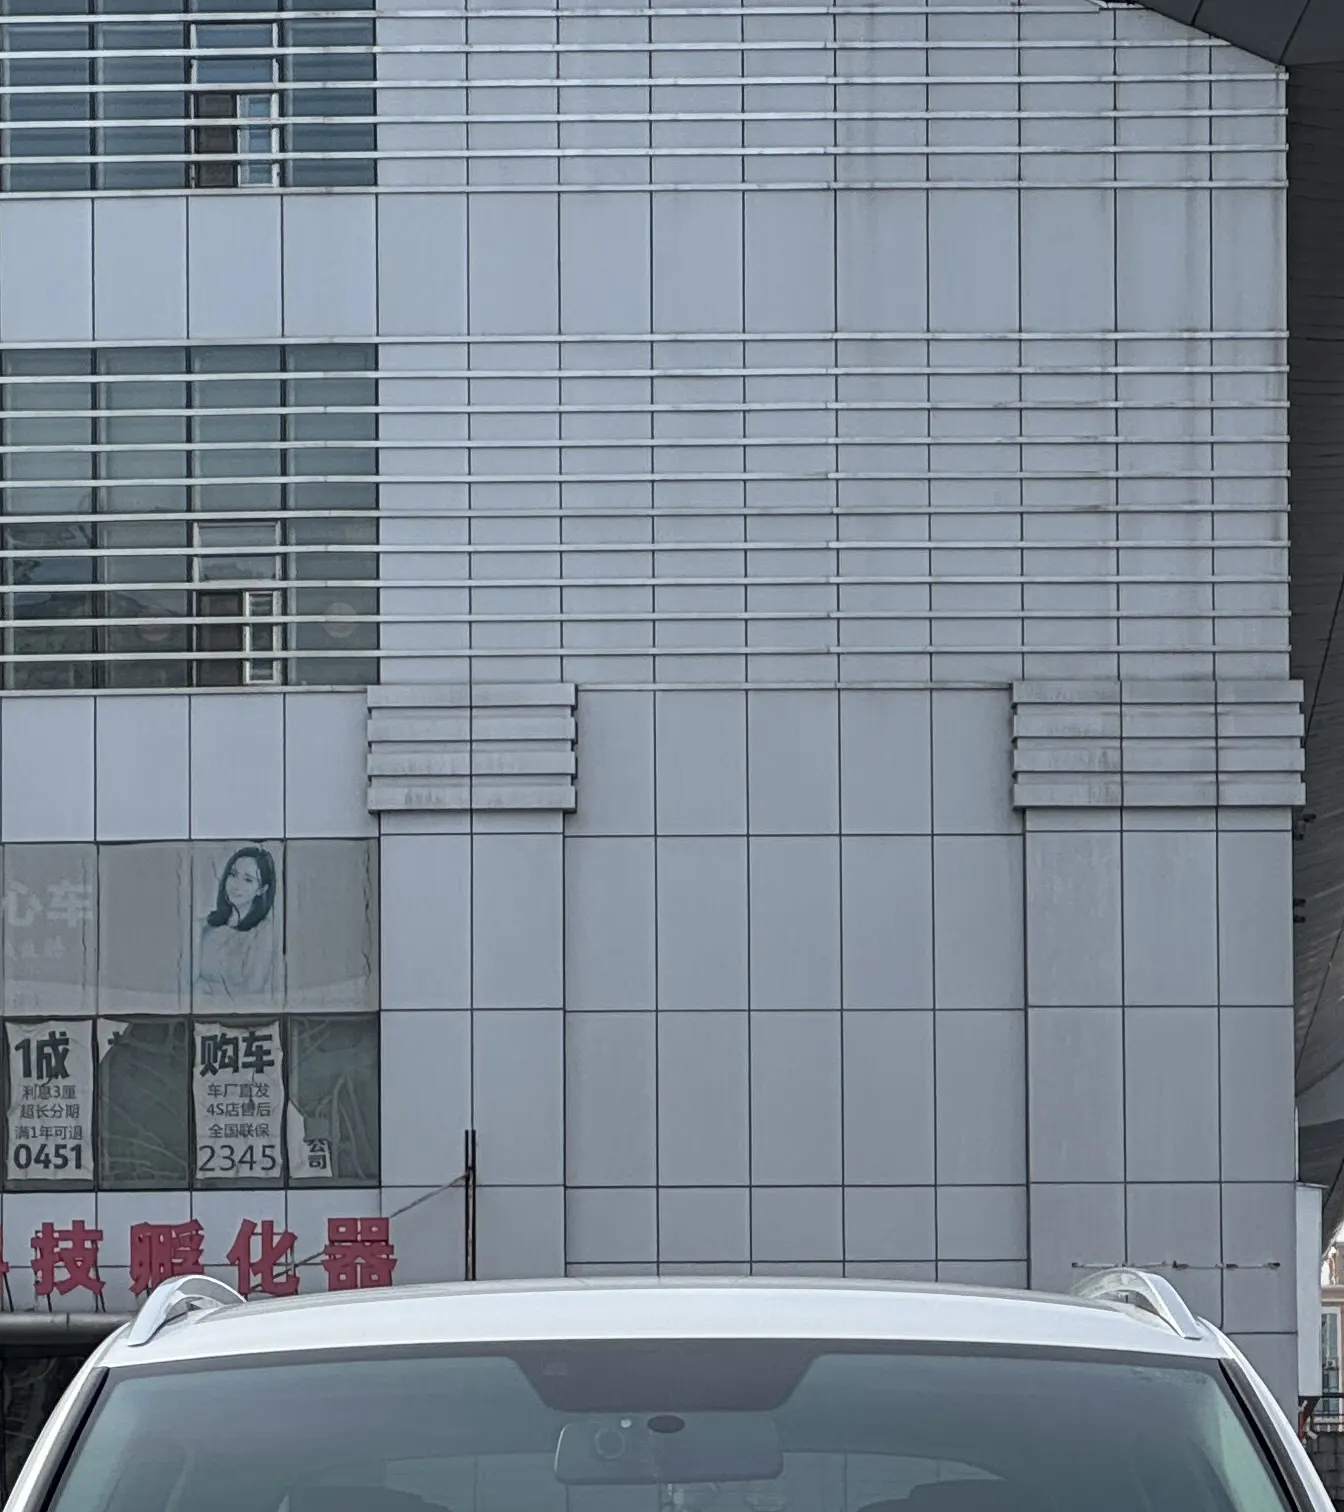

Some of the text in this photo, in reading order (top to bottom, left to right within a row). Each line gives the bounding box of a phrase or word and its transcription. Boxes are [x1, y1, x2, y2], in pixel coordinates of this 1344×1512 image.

[14, 1030, 71, 1080] 1成
[199, 1030, 275, 1077] 购车
[22, 1084, 77, 1100] 利息3厘
[207, 1083, 271, 1098] 车厂直发
[19, 1103, 80, 1119] 超长分期
[206, 1101, 272, 1117] 4S店售后
[14, 1125, 83, 1140] 满1年可退
[208, 1123, 271, 1139] 全国联保
[13, 1143, 82, 1170] 0451
[198, 1144, 277, 1171] 2345
[307, 1139, 328, 1169] 公司
